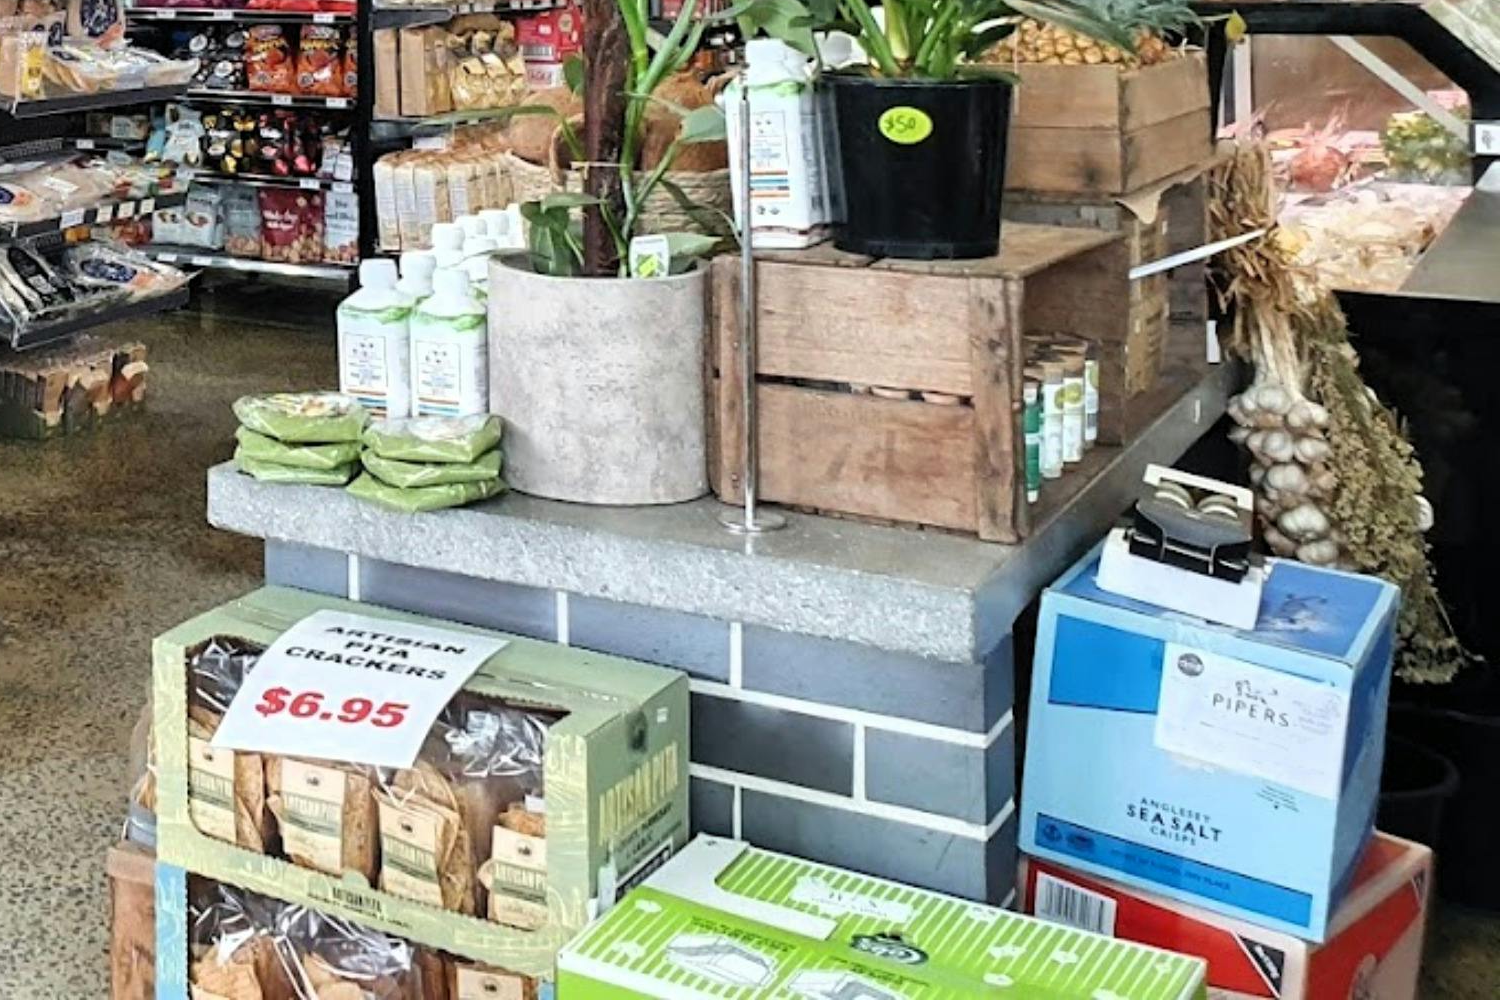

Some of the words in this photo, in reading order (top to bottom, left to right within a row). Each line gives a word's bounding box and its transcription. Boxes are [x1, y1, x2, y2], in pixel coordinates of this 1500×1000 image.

[285, 646, 448, 681] CRACKERS
[344, 640, 409, 659] PITA
[255, 686, 409, 728] $6.95
[1212, 692, 1289, 728] PIPERS
[1126, 803, 1165, 826] SEA
[1170, 816, 1223, 843] SALT
[1150, 825, 1197, 847] CRISPS
